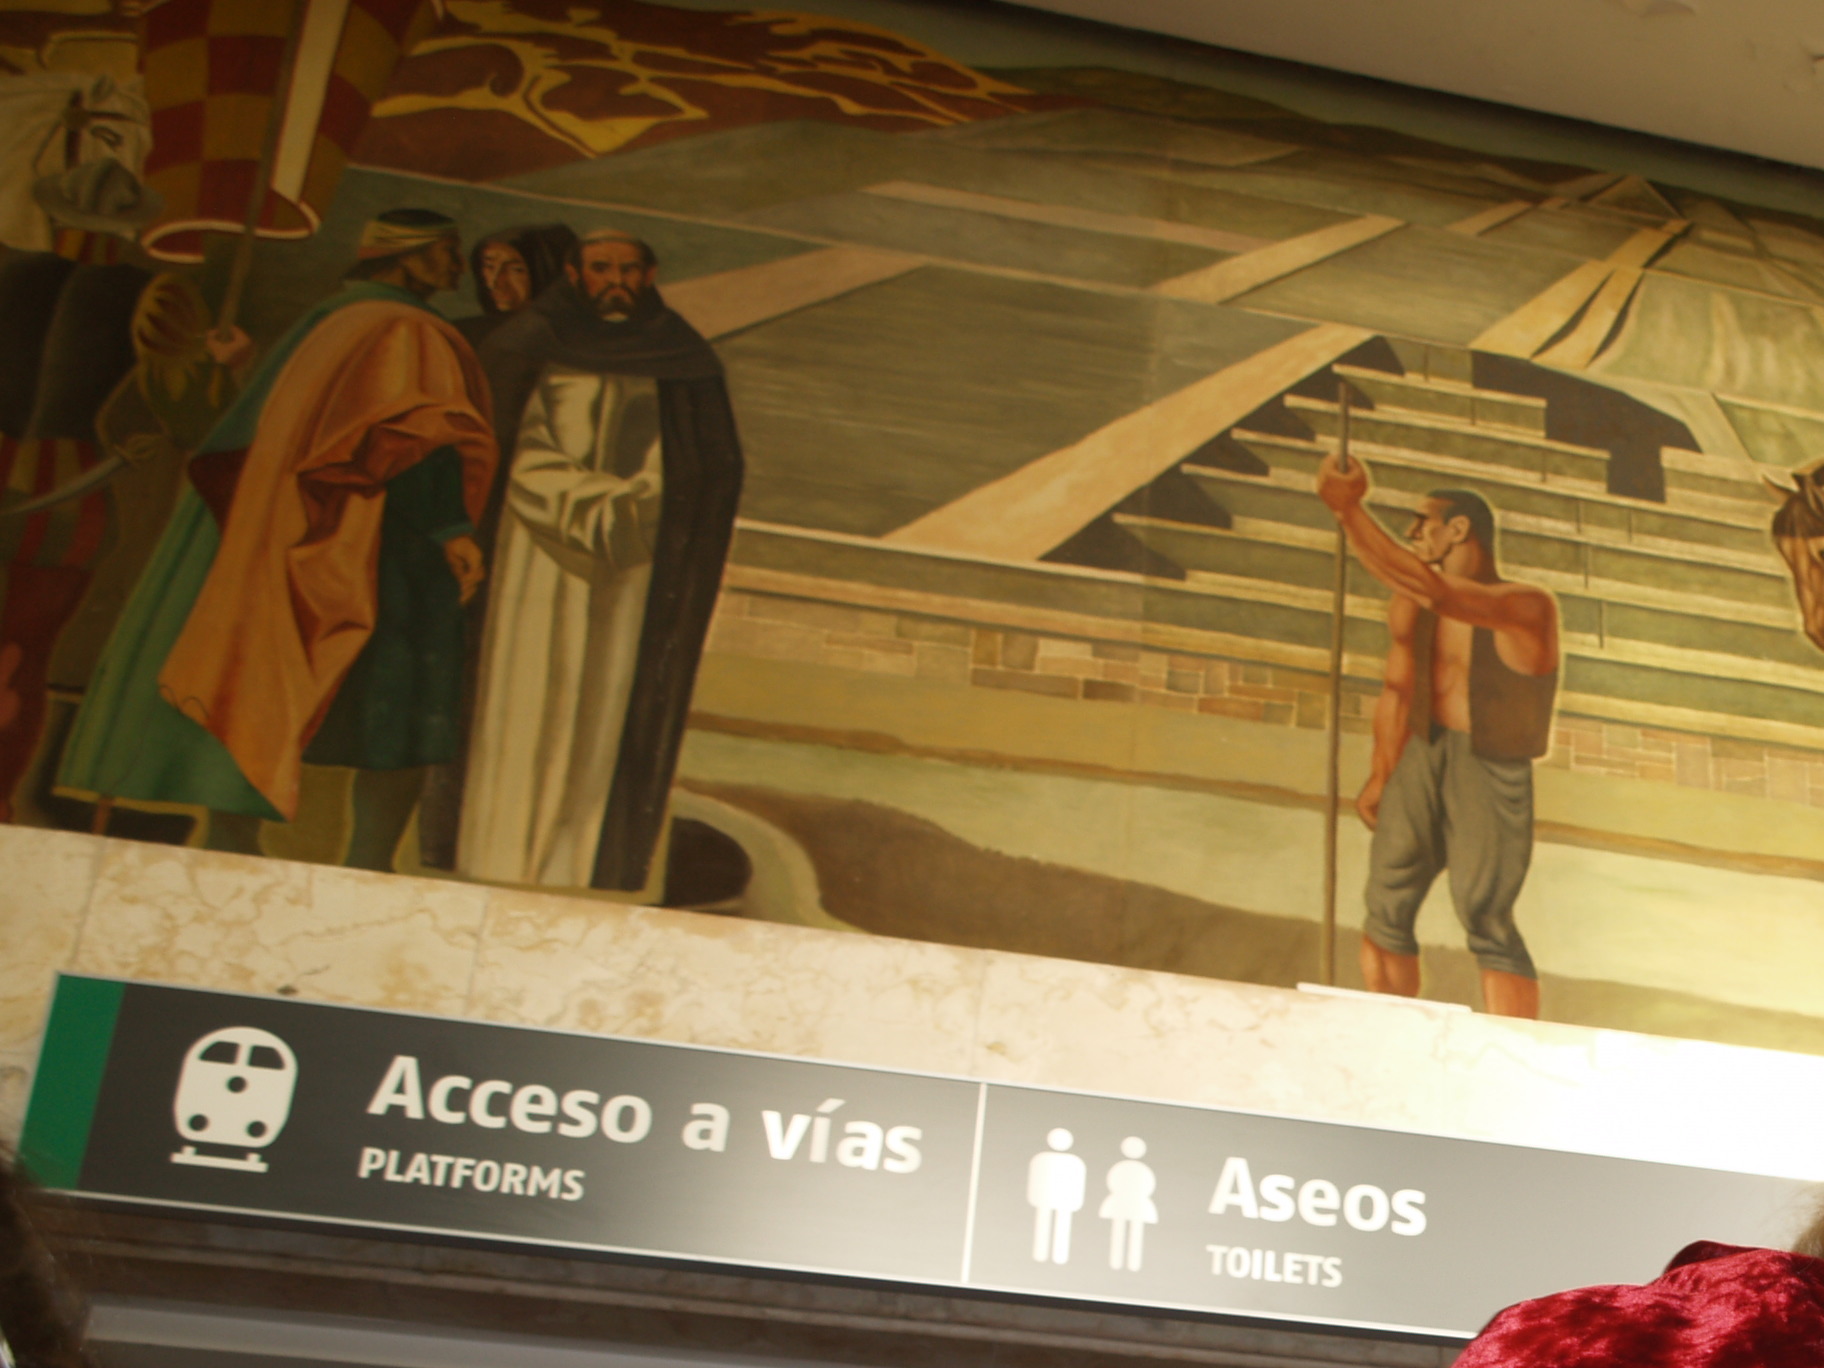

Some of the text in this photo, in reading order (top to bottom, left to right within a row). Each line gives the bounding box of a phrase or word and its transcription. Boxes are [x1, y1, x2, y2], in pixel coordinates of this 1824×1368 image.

[366, 1055, 923, 1175] Acceso a vías
[357, 1146, 587, 1202] PLATFORMS
[1208, 1156, 1428, 1237] Aseos
[1206, 1244, 1343, 1288] TOILETS
